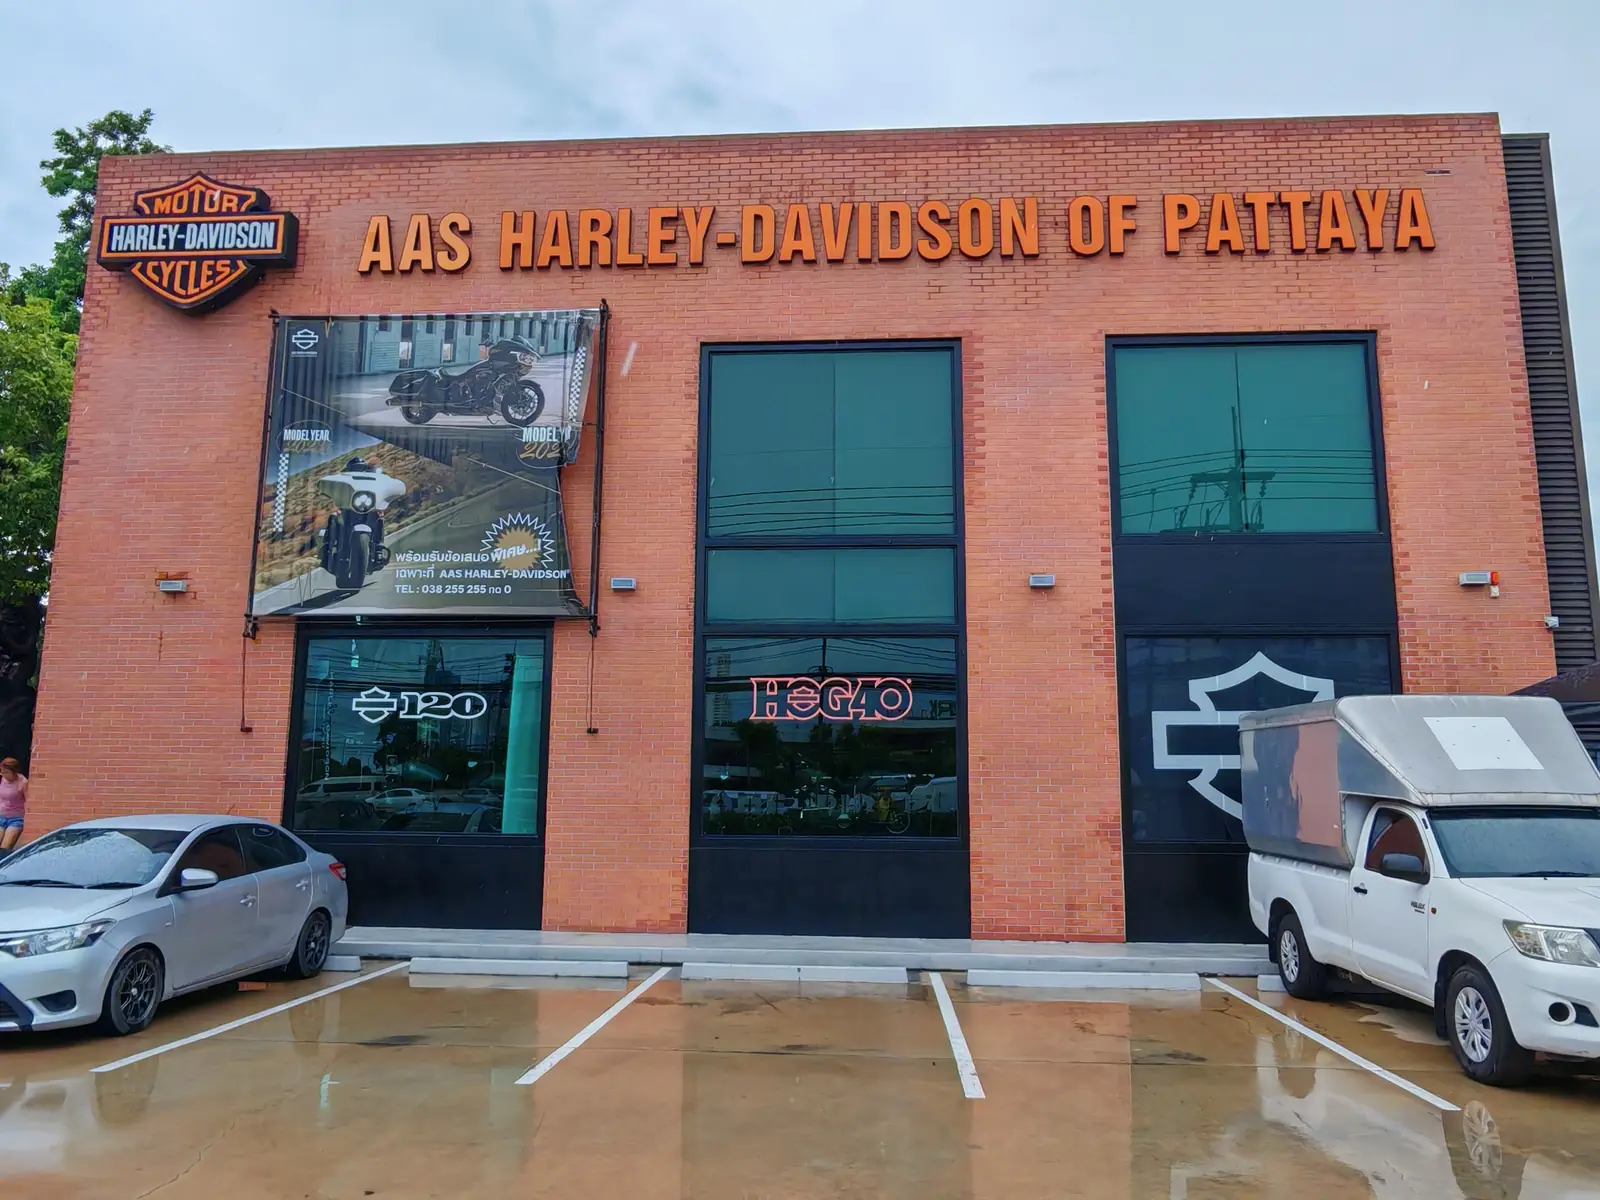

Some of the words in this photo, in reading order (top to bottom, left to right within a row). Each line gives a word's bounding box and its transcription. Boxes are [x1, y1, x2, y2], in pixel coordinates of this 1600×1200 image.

[153, 185, 239, 215] MOTOR
[110, 221, 275, 251] HARLEY-DAVIDSON
[357, 212, 472, 274] AAS
[499, 196, 1040, 272] HARLEY-DAVIDSON
[1067, 194, 1138, 257] OF
[1163, 188, 1436, 254] PATTAYA
[146, 260, 232, 295] CYCLES
[283, 428, 309, 441] MODEL
[310, 428, 332, 442] YEAR
[522, 426, 559, 443] MODEL
[439, 569, 463, 578] AAS
[464, 568, 567, 579] HARLEY-DAVIDSON
[394, 584, 414, 594] TEL
[421, 584, 443, 594] 038
[444, 584, 465, 594] 255
[466, 584, 487, 594] 255
[503, 584, 512, 594] 0
[399, 691, 488, 719] 120
[749, 677, 913, 721] HOG40
